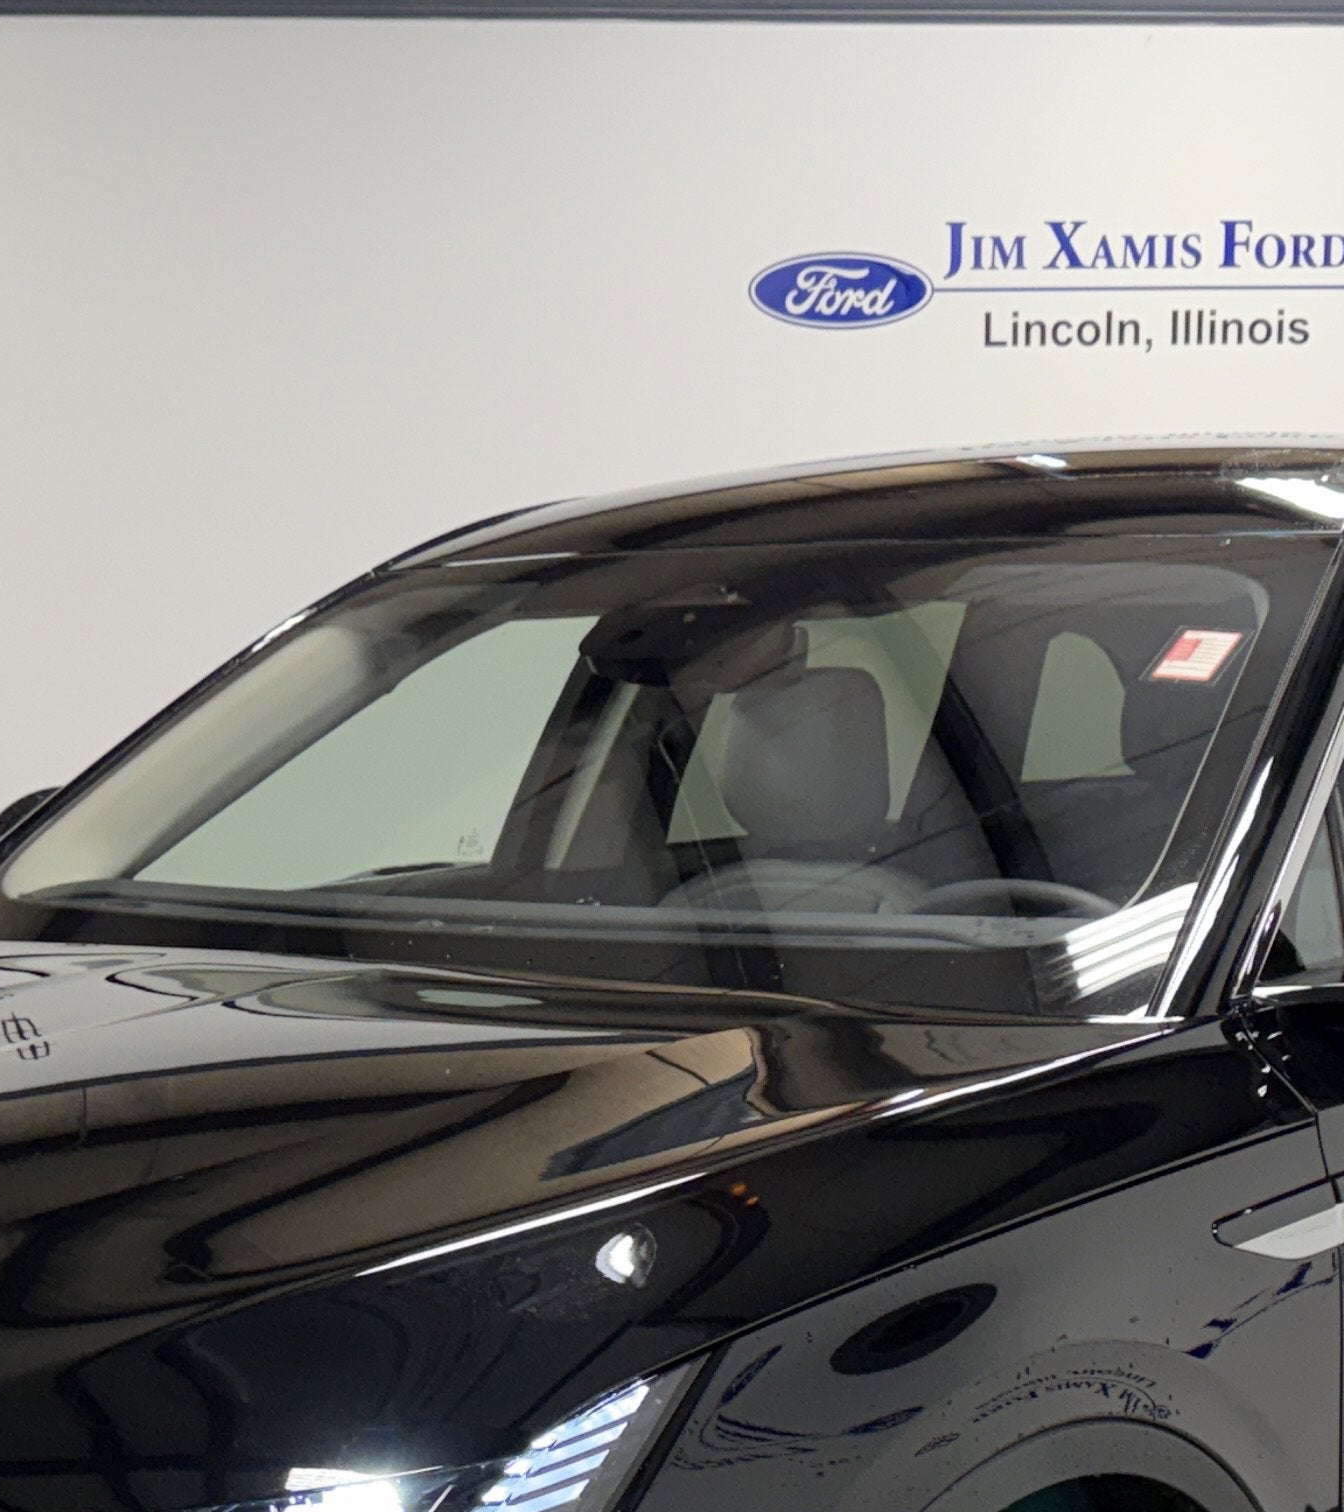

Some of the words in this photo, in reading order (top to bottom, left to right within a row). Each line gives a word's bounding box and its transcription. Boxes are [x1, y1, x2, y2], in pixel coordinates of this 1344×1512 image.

[943, 220, 1027, 281] JIM
[1043, 220, 1203, 270] XAMIS
[785, 266, 896, 316] Ford
[983, 309, 1154, 354] Lincoln,
[1170, 308, 1311, 346] Illinois
